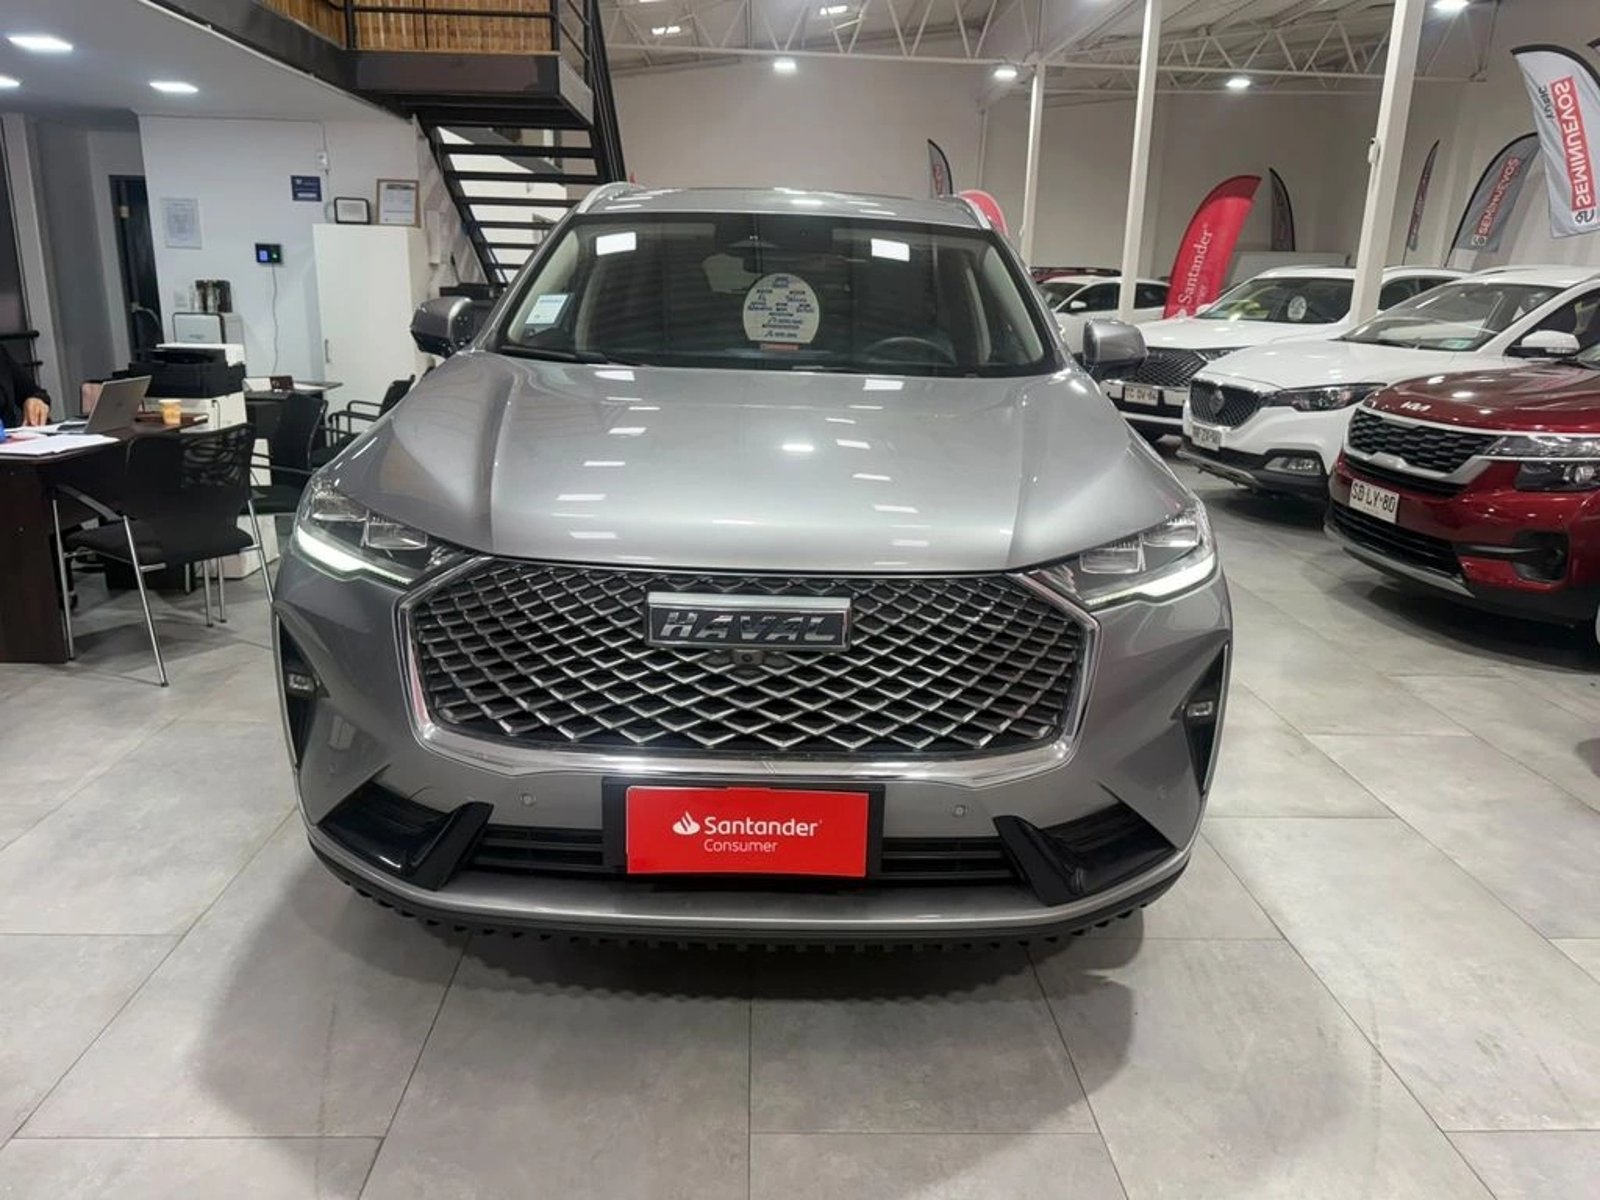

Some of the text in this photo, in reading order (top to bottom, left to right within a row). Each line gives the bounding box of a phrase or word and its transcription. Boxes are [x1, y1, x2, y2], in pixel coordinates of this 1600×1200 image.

[1178, 228, 1213, 304] Santander
[659, 611, 836, 641] HAVAL
[704, 816, 818, 837] Santander
[703, 838, 778, 853] Consumer
